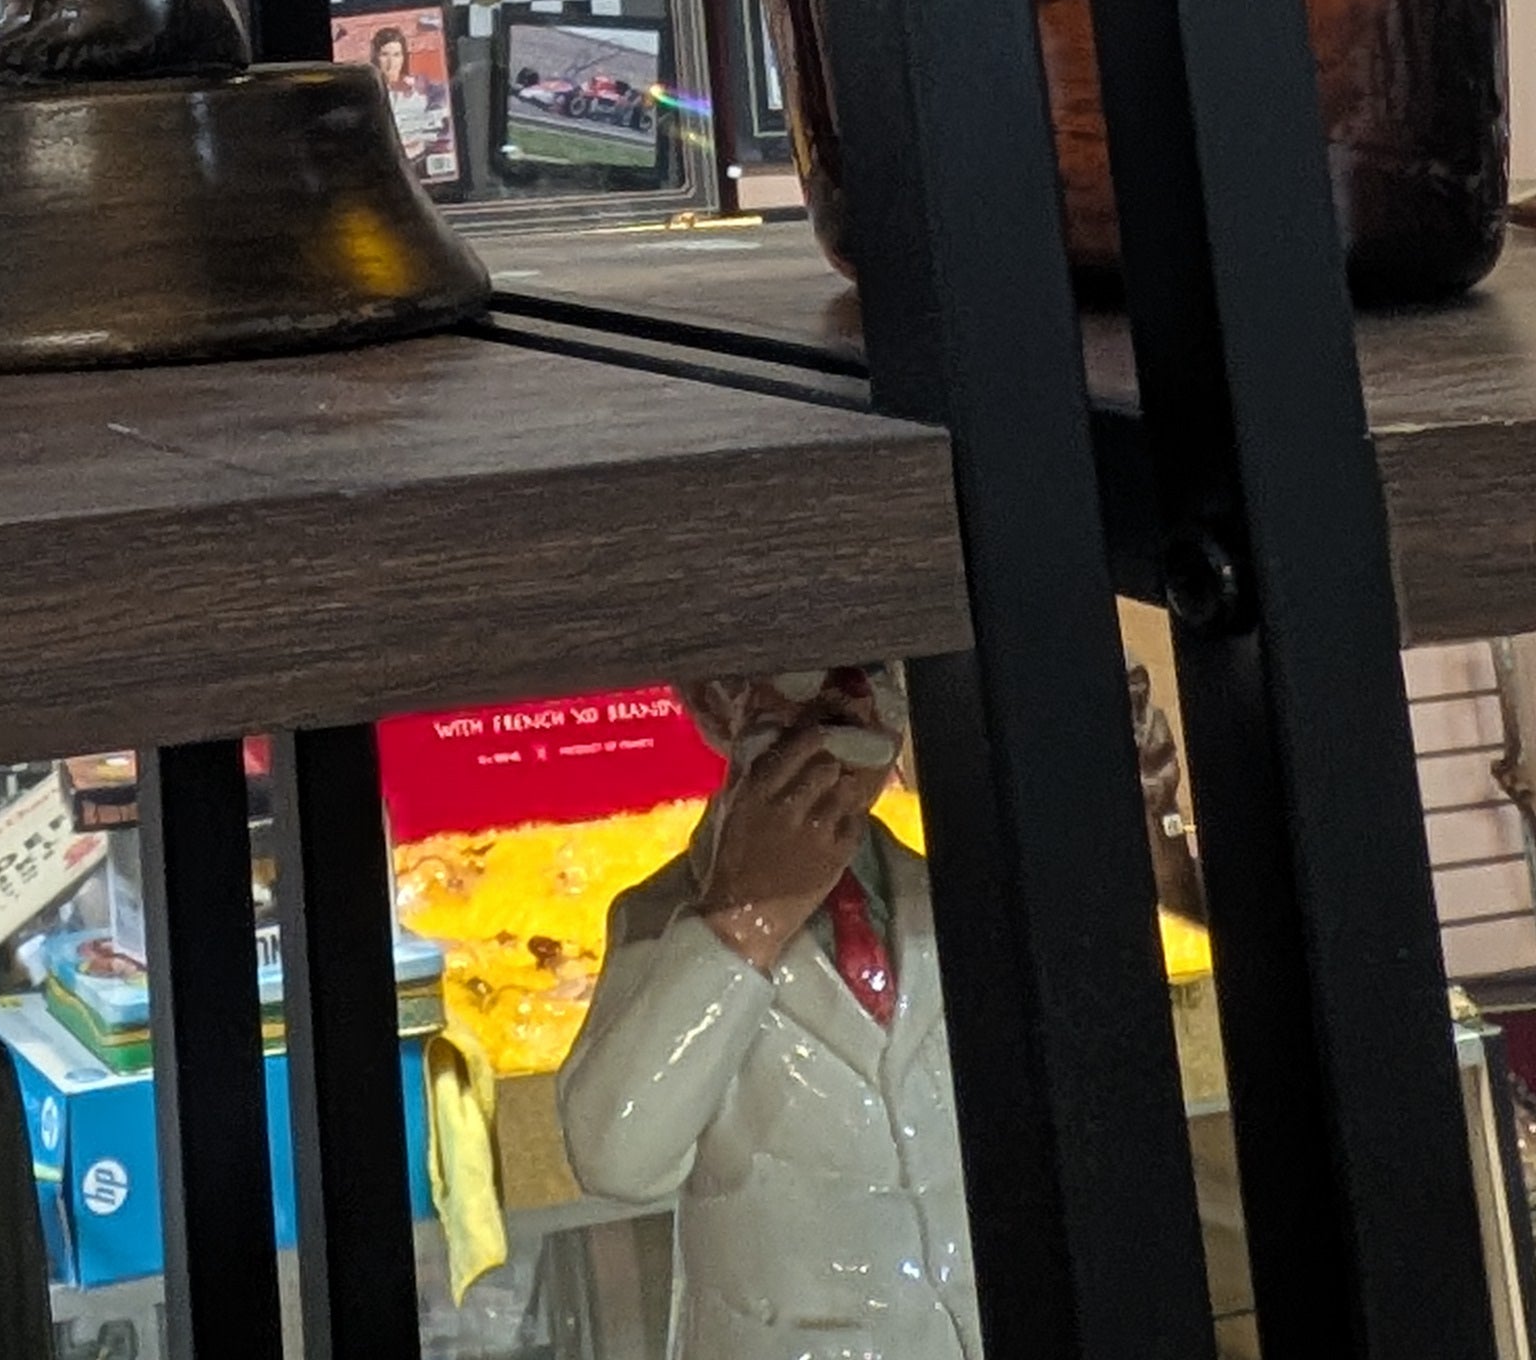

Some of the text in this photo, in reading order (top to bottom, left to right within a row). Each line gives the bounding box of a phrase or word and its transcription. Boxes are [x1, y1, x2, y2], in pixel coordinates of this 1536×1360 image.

[433, 717, 483, 739] WITH
[493, 710, 565, 733] FRENCH
[83, 1166, 128, 1206] hp
